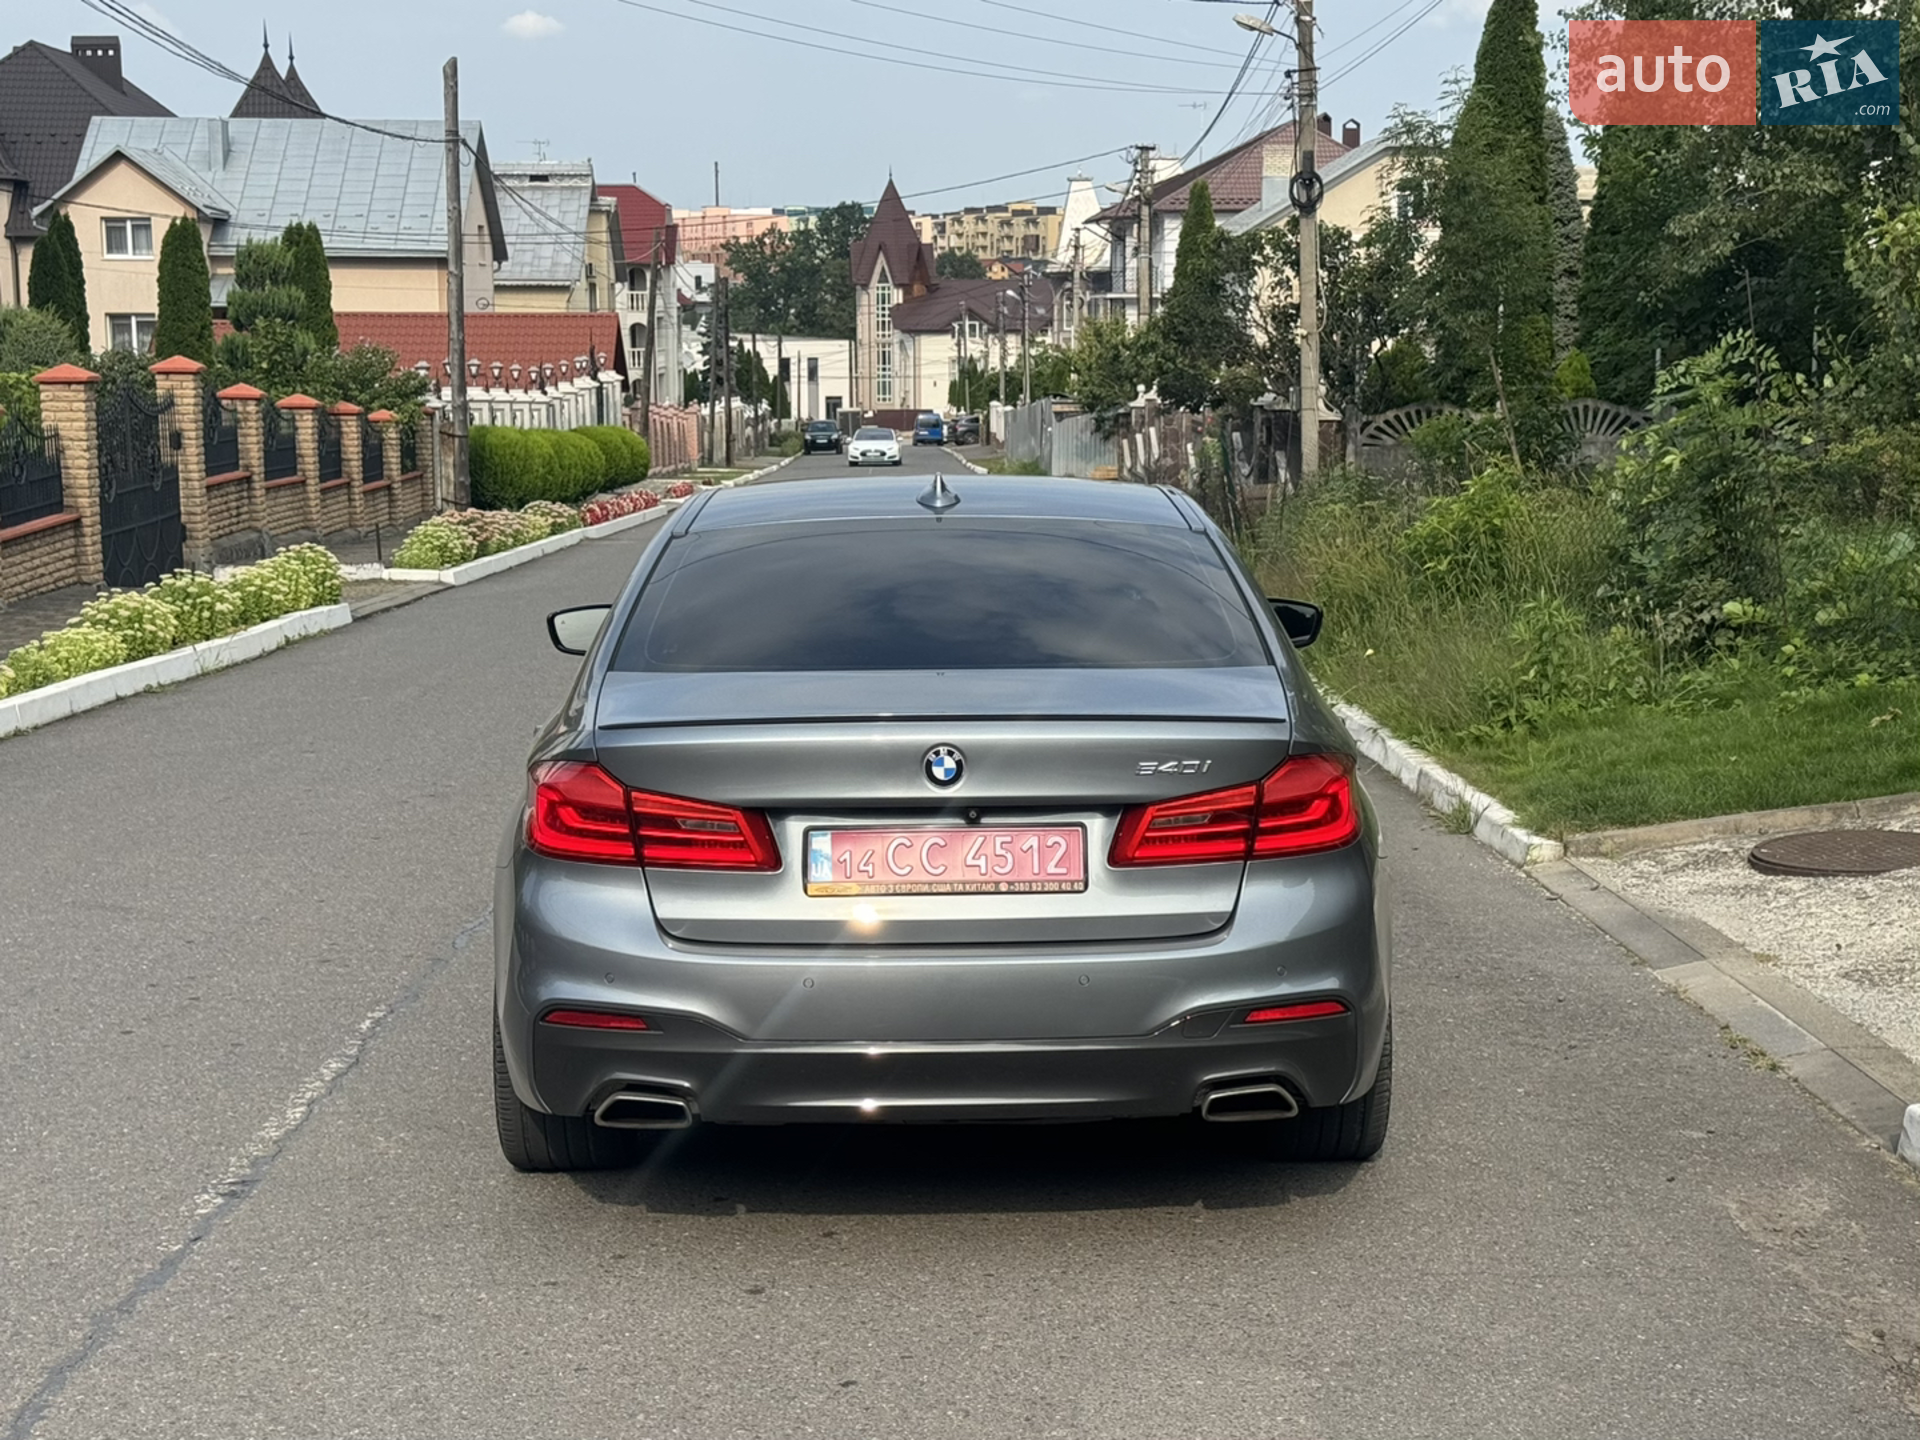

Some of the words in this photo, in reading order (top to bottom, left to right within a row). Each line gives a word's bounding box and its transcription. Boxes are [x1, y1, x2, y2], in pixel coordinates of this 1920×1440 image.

[1136, 760, 1212, 776] 540i
[837, 849, 875, 879] 14
[886, 836, 948, 877] CC
[965, 835, 1068, 876] 4512
